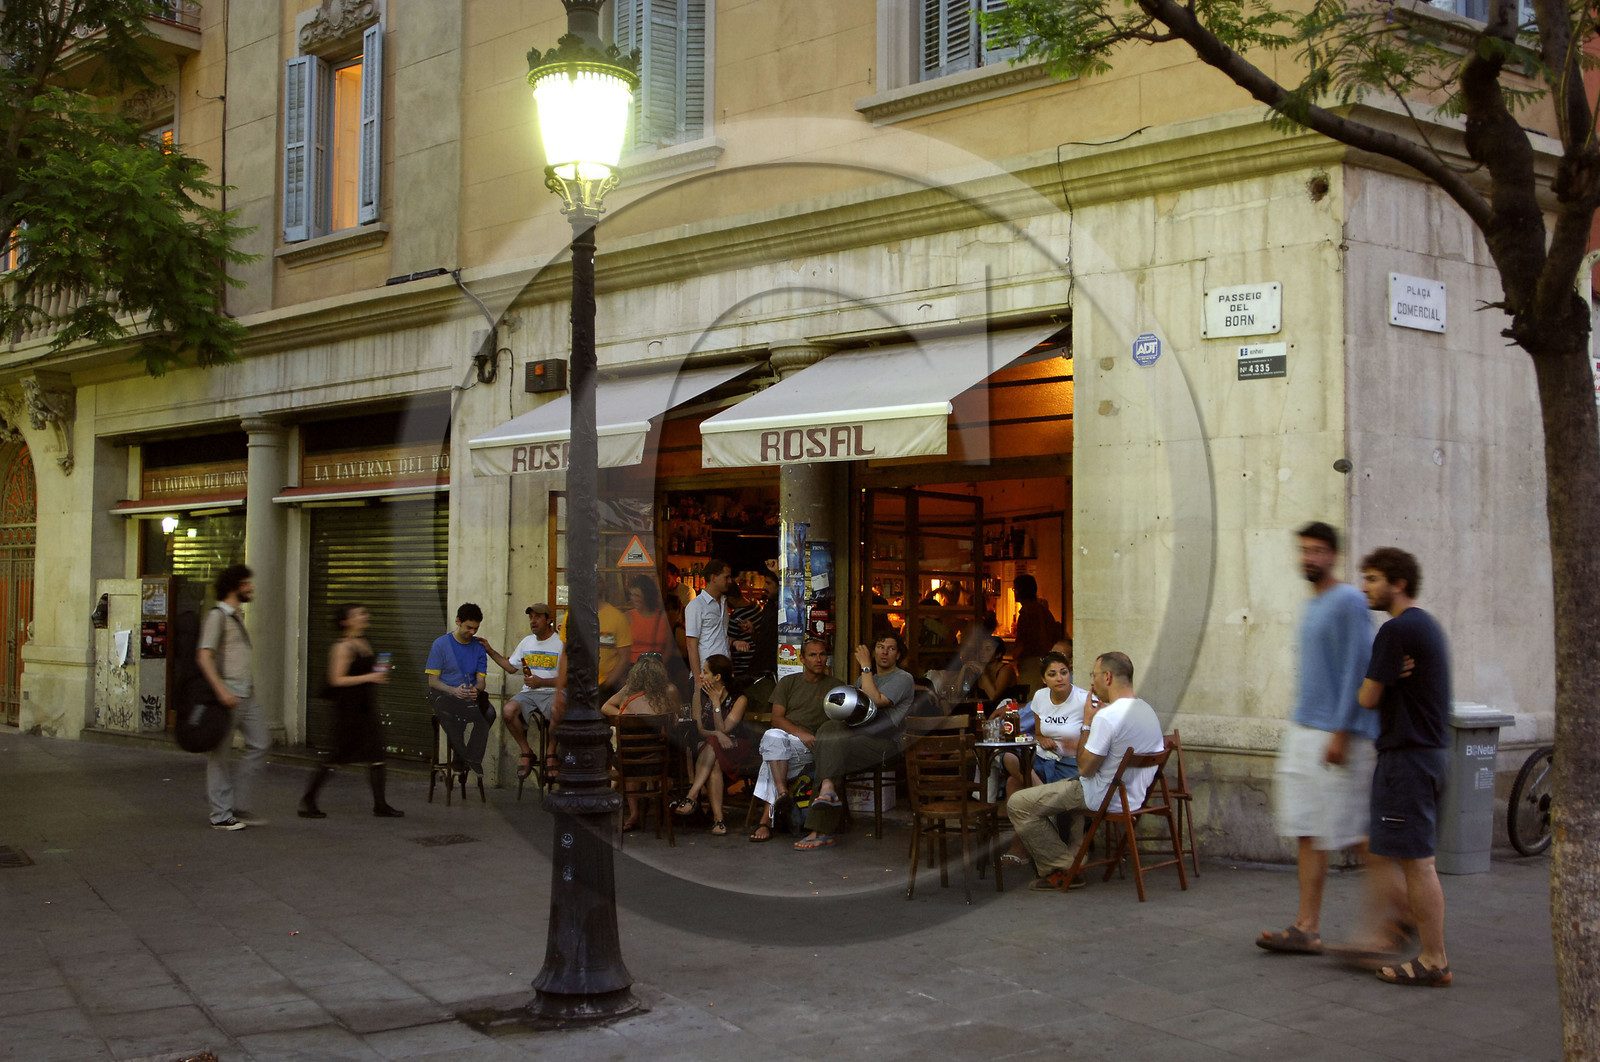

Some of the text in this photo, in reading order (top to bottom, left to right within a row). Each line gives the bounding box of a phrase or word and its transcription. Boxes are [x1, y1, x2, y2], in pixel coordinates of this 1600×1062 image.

[1218, 291, 1262, 303] PASSEIG
[1406, 285, 1431, 300] PLAÇA
[1229, 303, 1249, 312] DEL
[1397, 301, 1440, 321] COMERCIAL
[1225, 314, 1255, 327] BORN
[1136, 341, 1157, 355] ADT
[1248, 363, 1270, 373] 4335
[760, 425, 875, 462] ROSAL
[512, 442, 570, 473] ROS
[314, 453, 450, 481] LA TAVERNA DEL BO
[152, 478, 162, 493] LA
[165, 475, 201, 492] TAVERNA
[204, 473, 221, 489] DEL
[1044, 716, 1069, 724] ONLY
